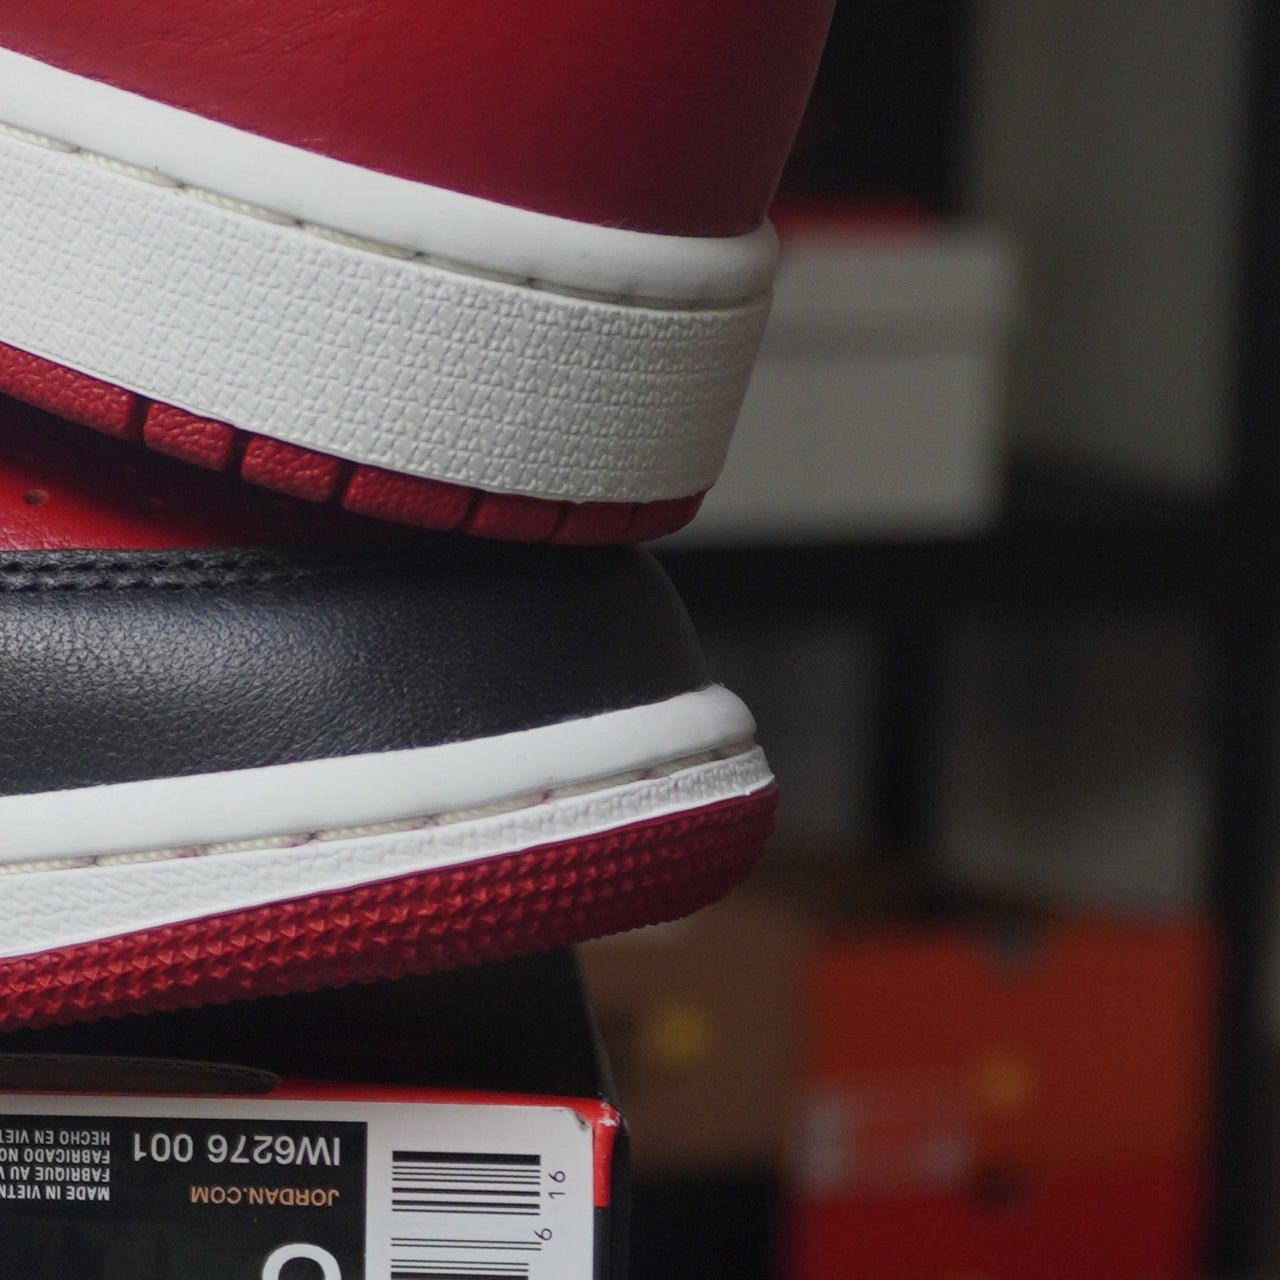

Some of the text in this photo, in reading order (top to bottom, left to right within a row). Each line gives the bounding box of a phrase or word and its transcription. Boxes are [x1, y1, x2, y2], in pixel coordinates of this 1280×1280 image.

[35, 1130, 53, 1144] EN
[60, 1131, 110, 1145] HECHO
[24, 1148, 110, 1164] FABRICADO
[134, 1134, 339, 1165] IW6276 001
[10, 1166, 30, 1180] AU
[35, 1167, 109, 1182] FABRIQUE
[46, 1186, 60, 1199] IN
[66, 1186, 109, 1200] MADE
[191, 1187, 339, 1206] JORDAN.COM
[534, 1228, 552, 1243] 6
[548, 1171, 566, 1200] 16
